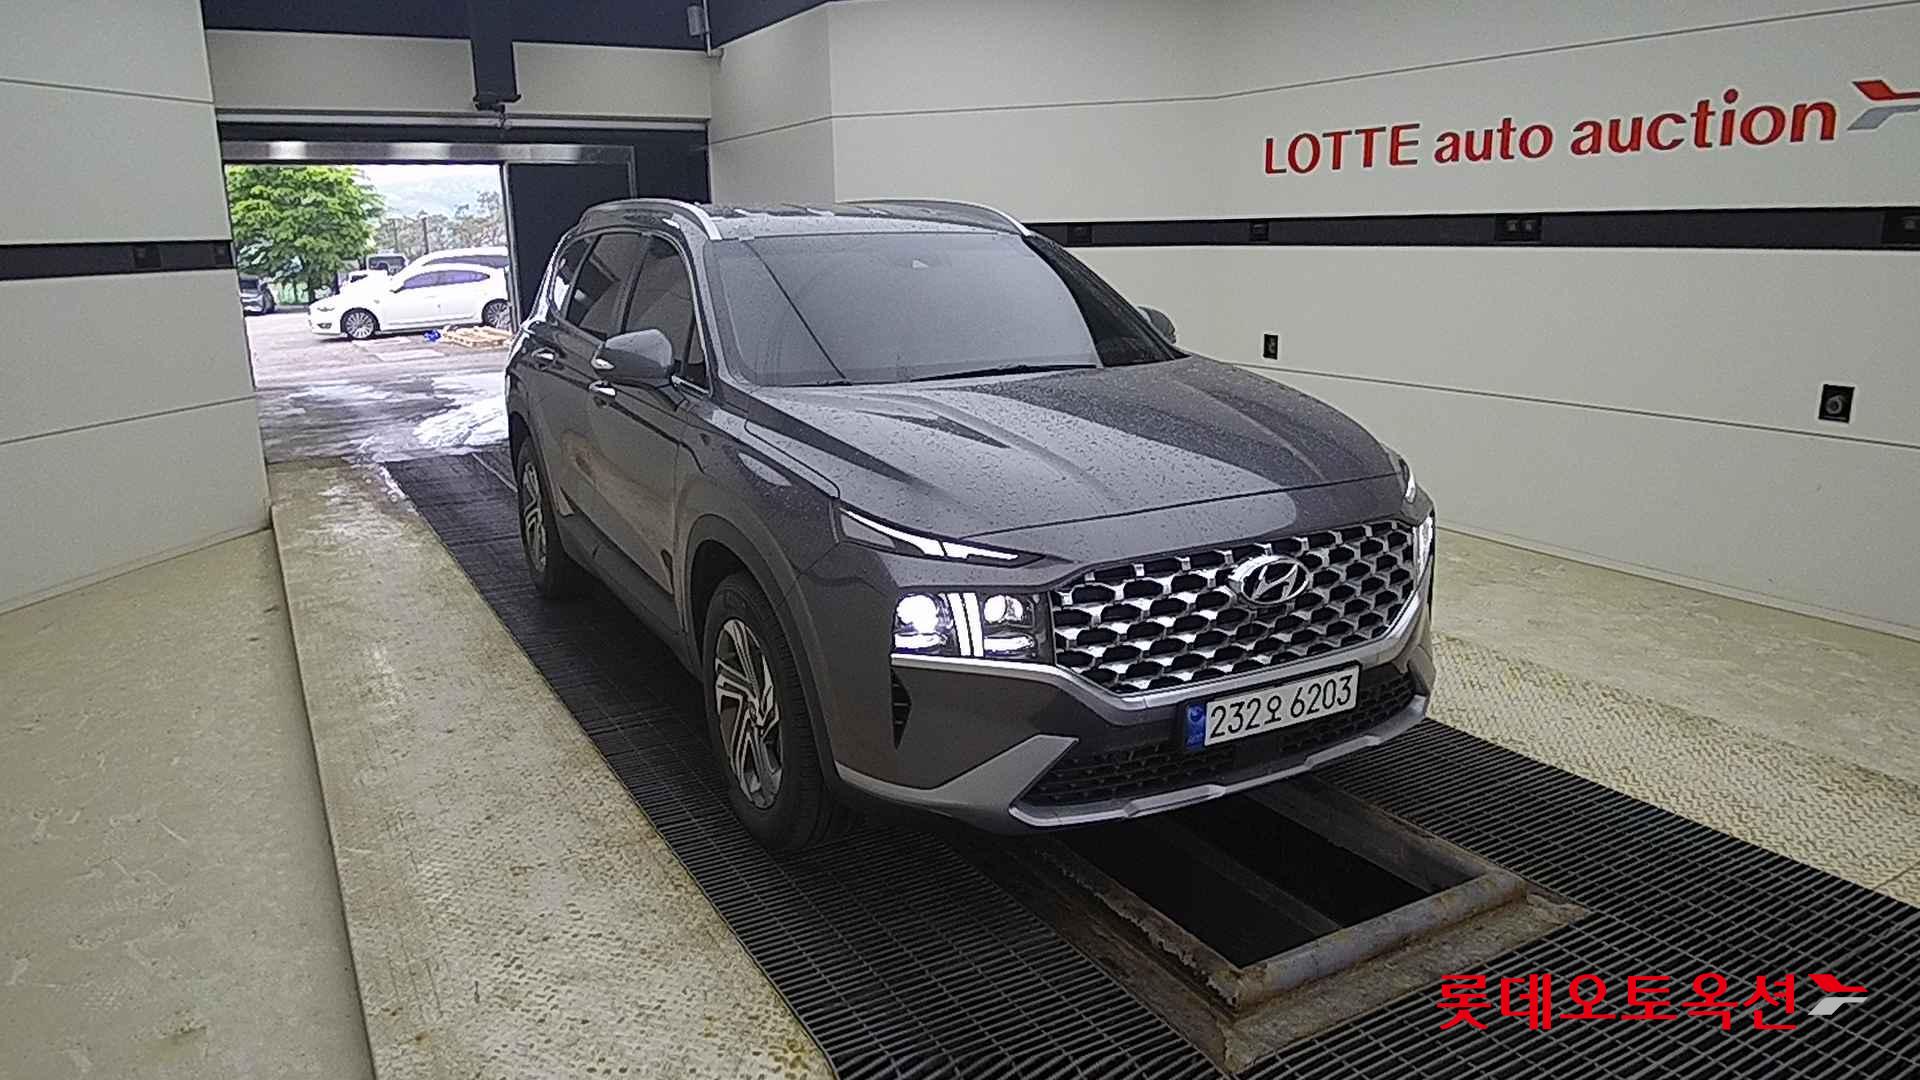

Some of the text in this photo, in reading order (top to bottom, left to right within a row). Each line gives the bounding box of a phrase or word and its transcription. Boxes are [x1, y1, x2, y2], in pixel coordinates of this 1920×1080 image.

[1264, 88, 1837, 175] LOTTE auto auction
[1209, 675, 1353, 738] 232오 6203
